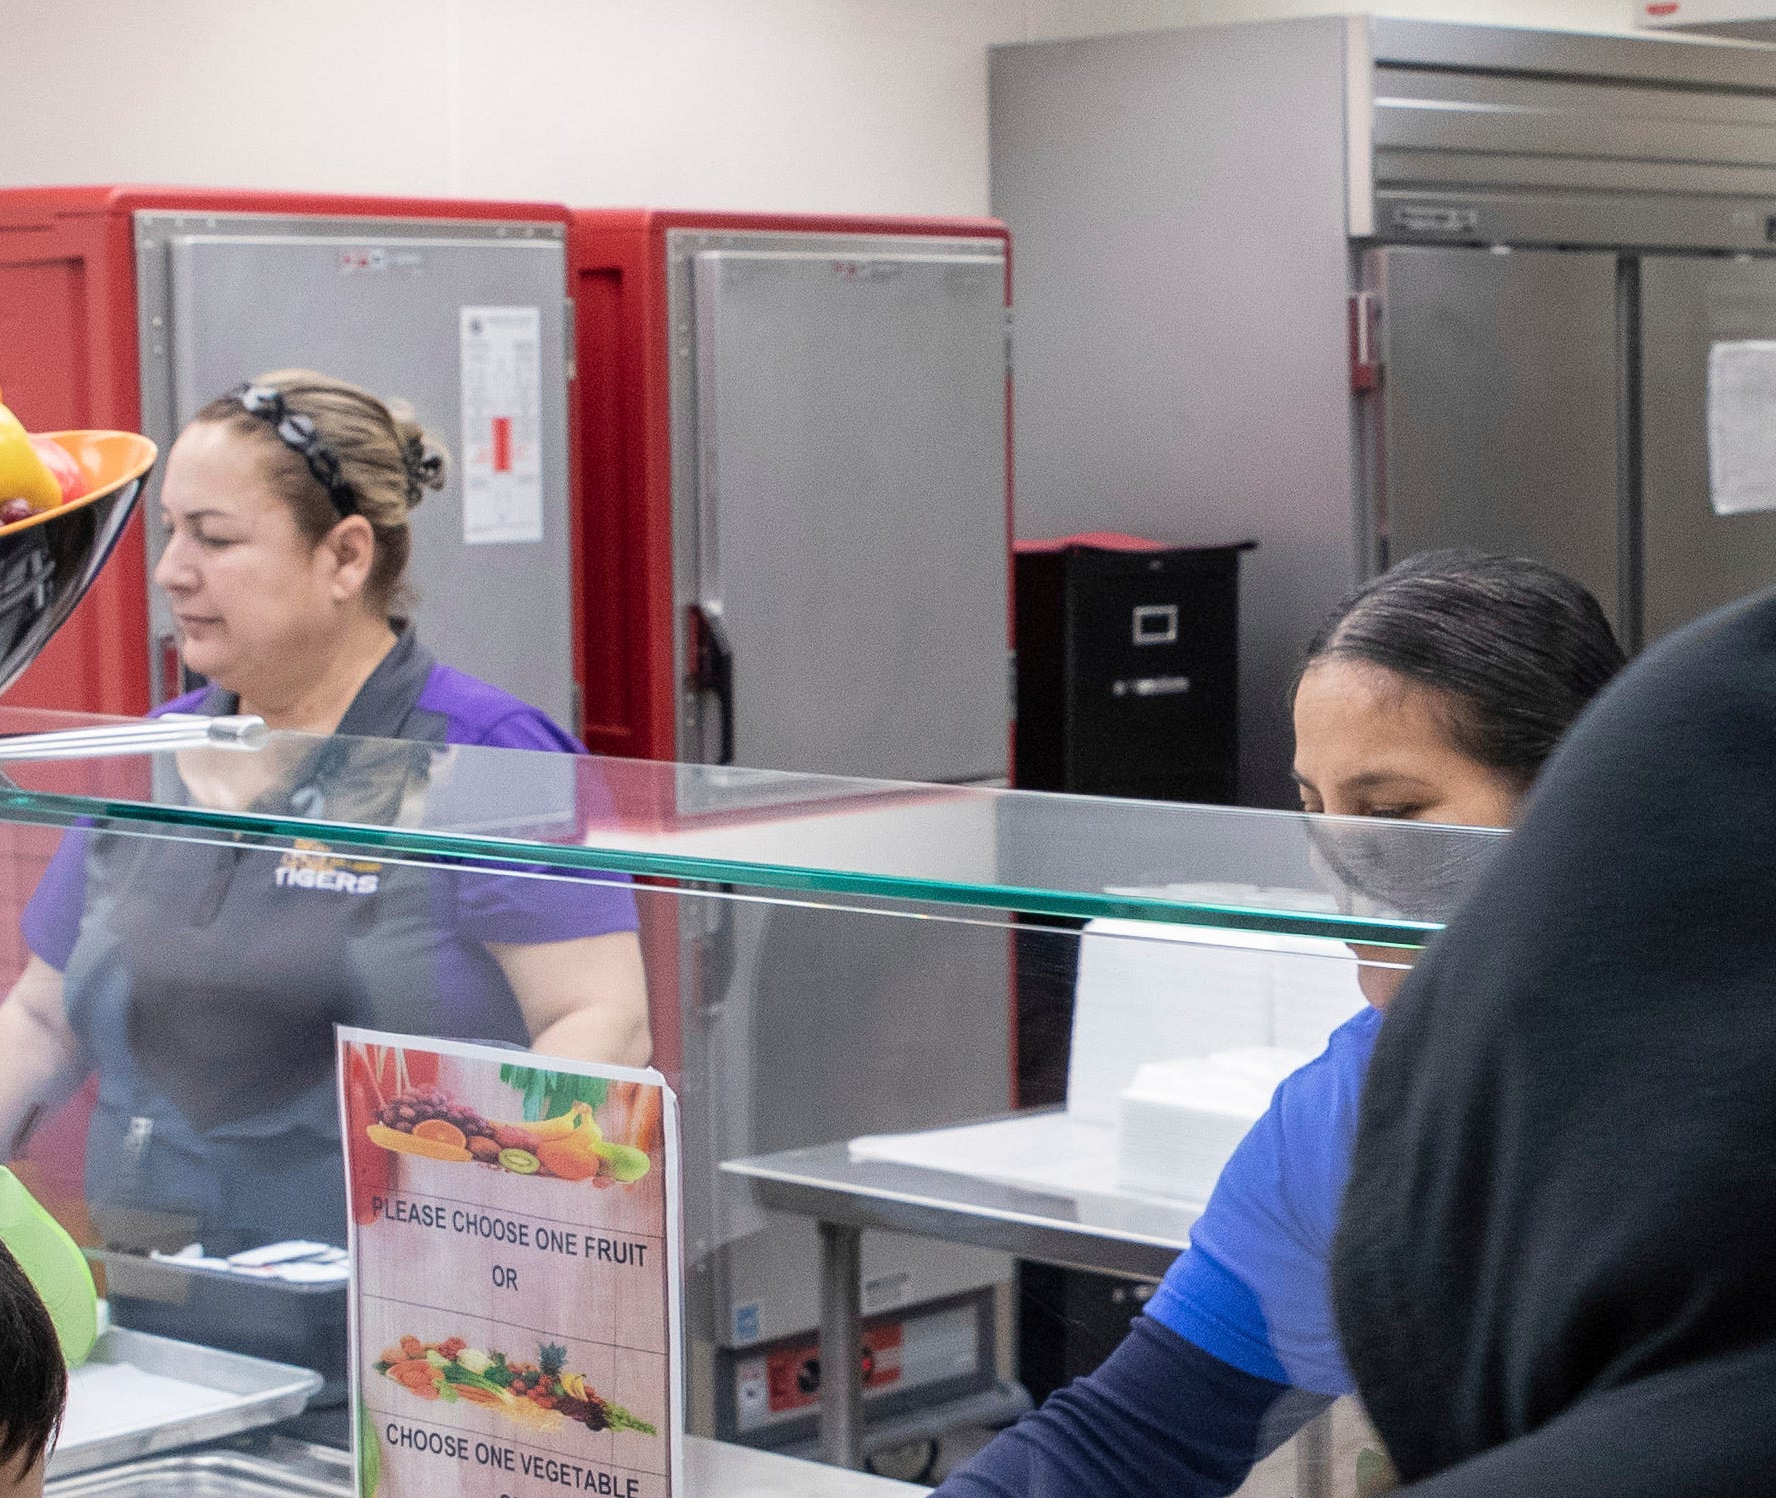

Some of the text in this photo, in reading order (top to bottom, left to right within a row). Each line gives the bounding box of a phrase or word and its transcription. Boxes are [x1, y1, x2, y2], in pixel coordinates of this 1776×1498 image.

[371, 1197, 648, 1267] PLEASE CHOOSE ONE FRUIT
[492, 1265, 519, 1291] OR
[386, 1423, 470, 1461] CHOOSE
[475, 1442, 516, 1472] ONE
